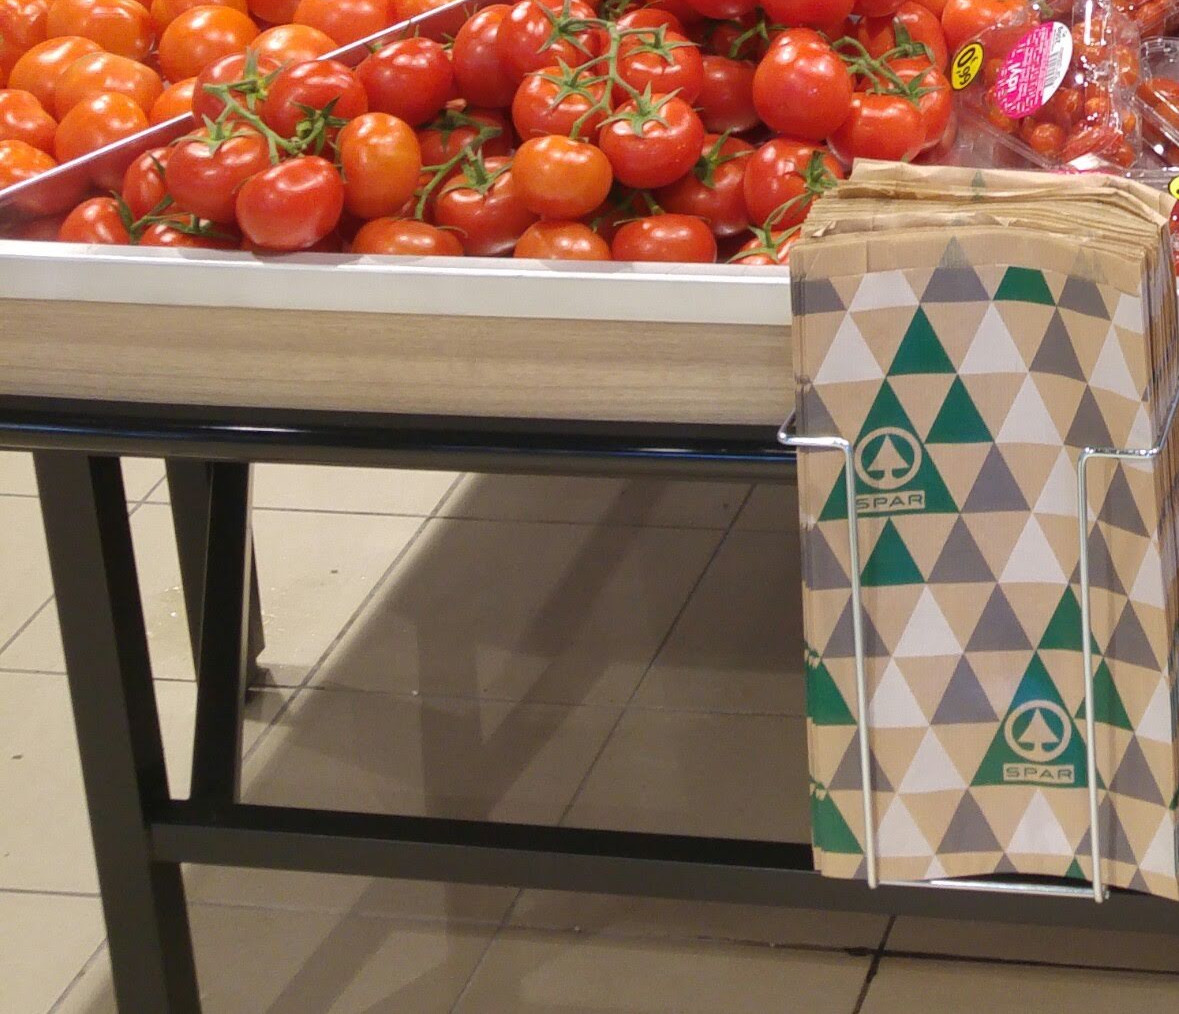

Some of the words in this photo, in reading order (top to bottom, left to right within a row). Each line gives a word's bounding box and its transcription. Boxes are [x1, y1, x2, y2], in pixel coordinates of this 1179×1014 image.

[1007, 63, 1022, 93] idyl
[856, 494, 922, 510] SPAR
[1006, 766, 1072, 780] SPAR
